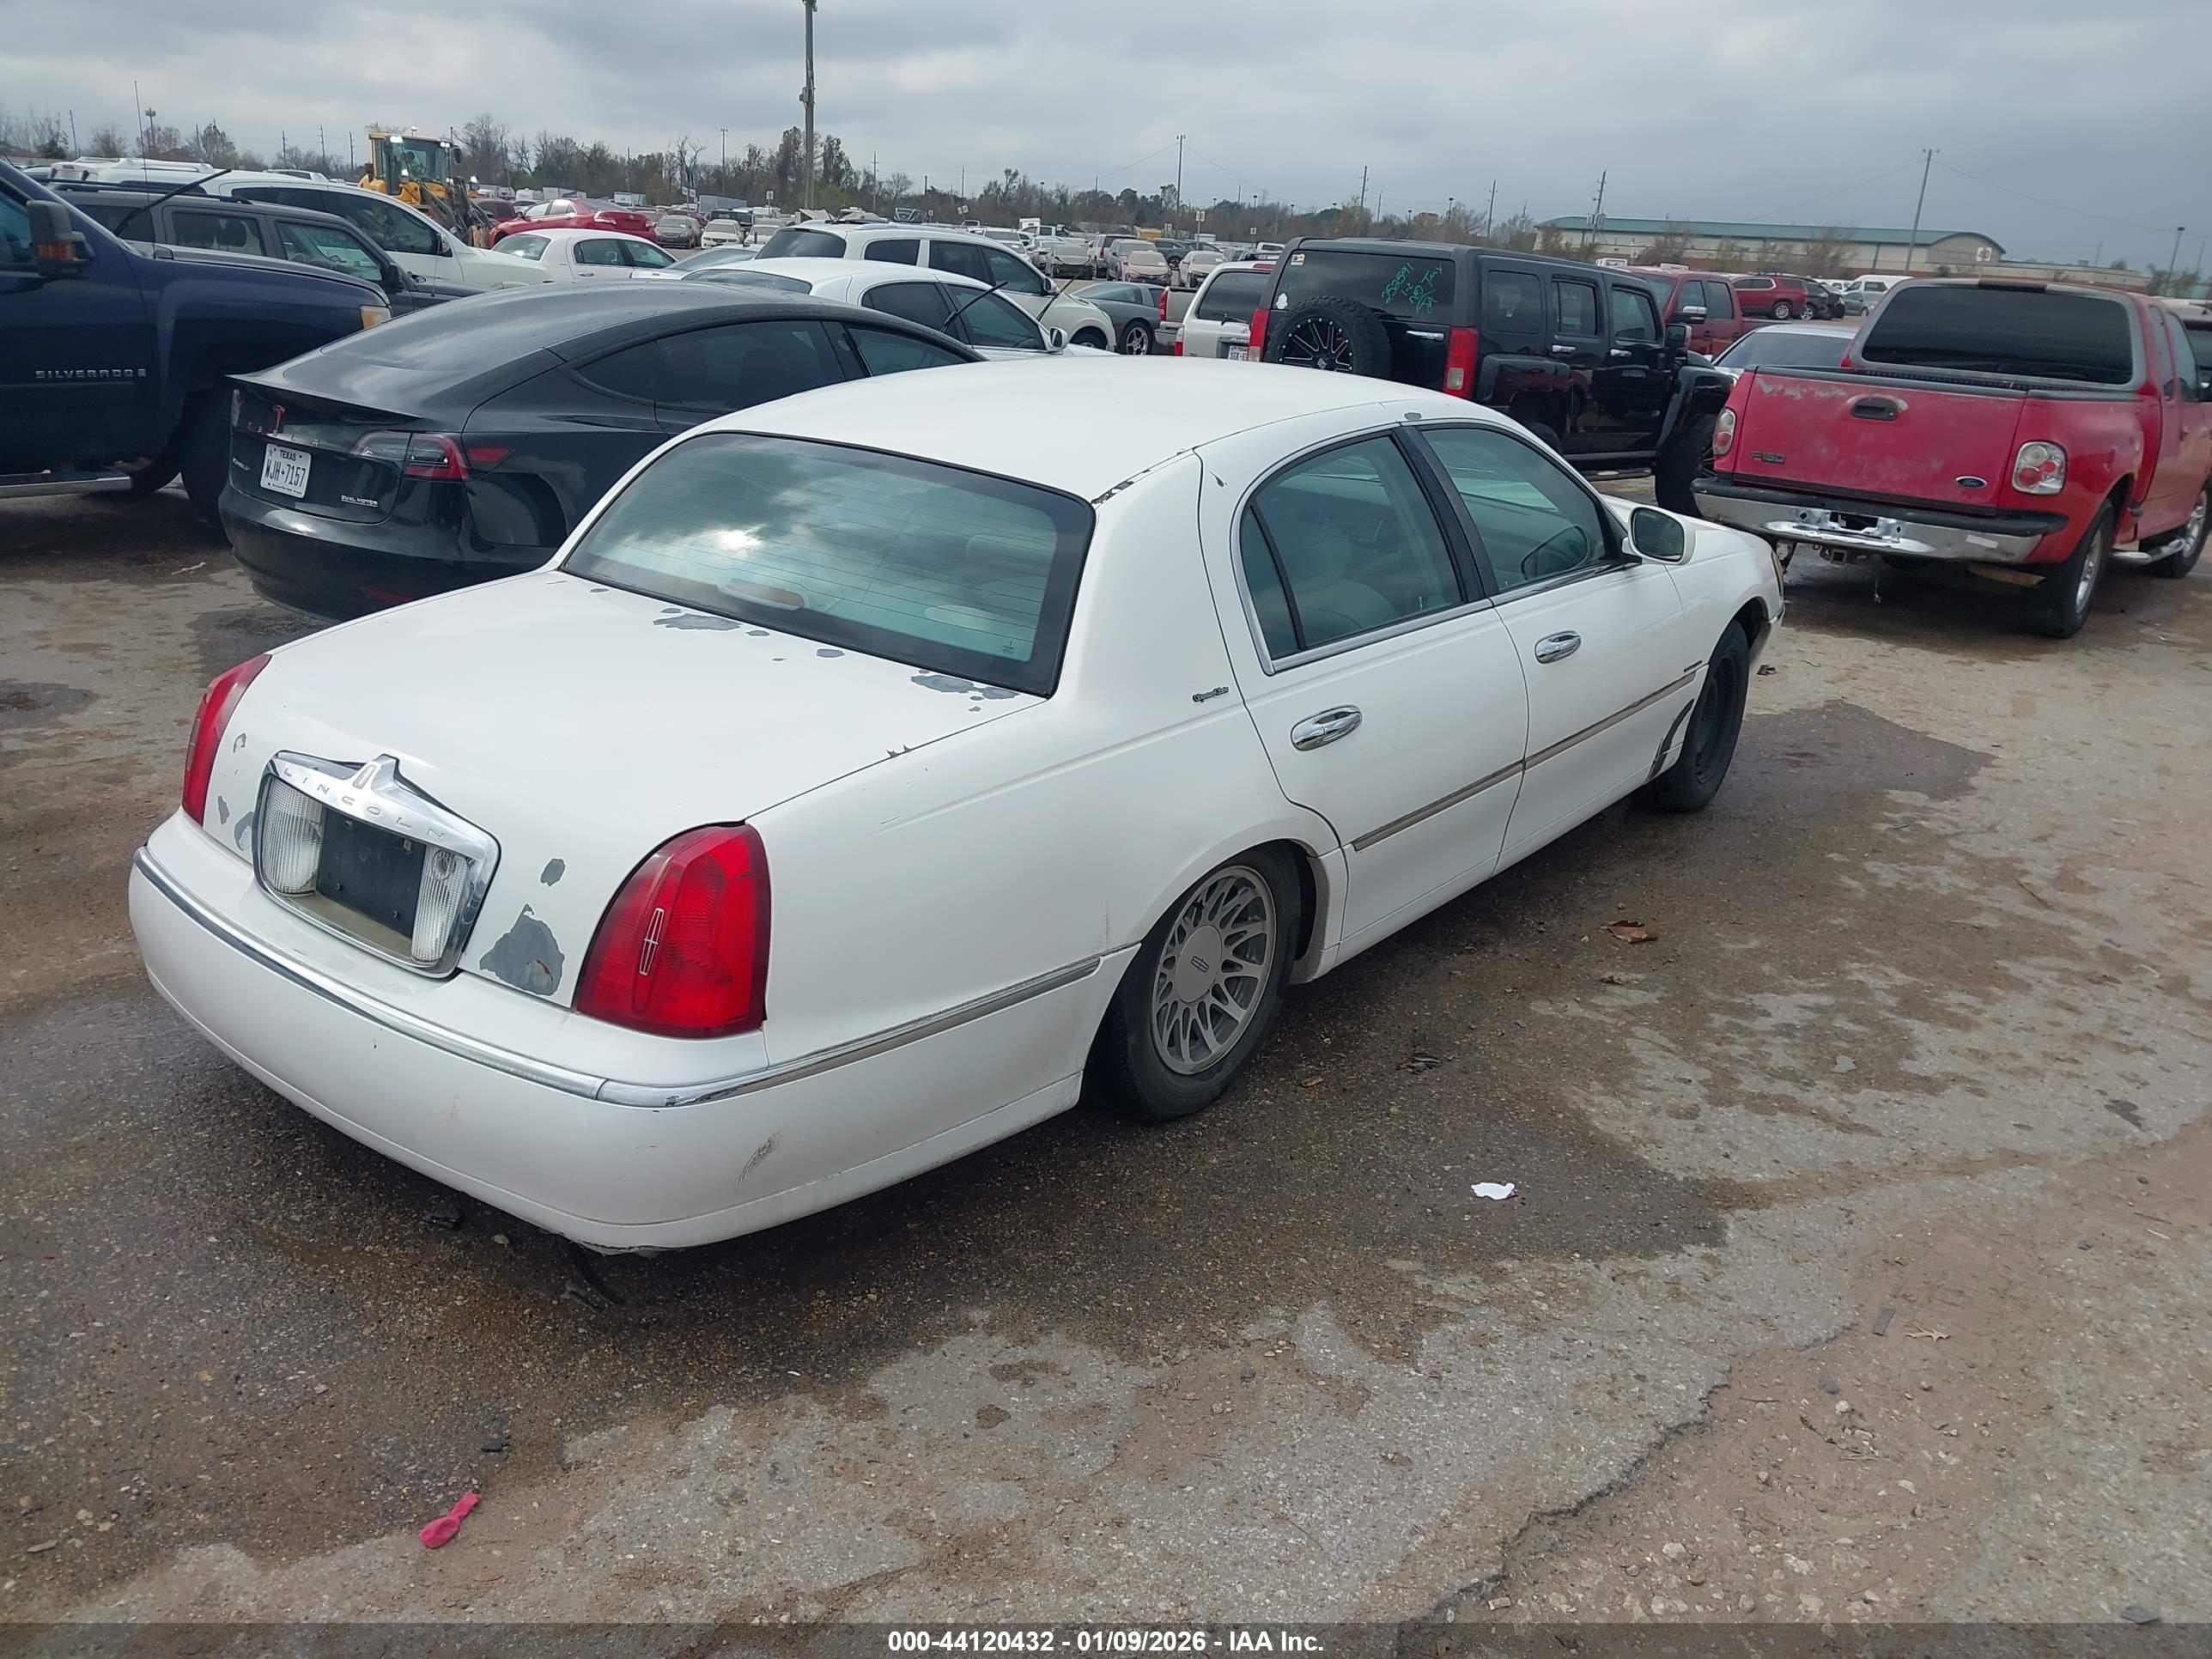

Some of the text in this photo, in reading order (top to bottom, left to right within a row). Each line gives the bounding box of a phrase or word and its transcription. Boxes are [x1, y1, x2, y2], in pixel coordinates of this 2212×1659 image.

[35, 368, 133, 379] SILVERADO
[280, 449, 297, 462] TEXAS
[283, 768, 446, 841] LINCOLN
